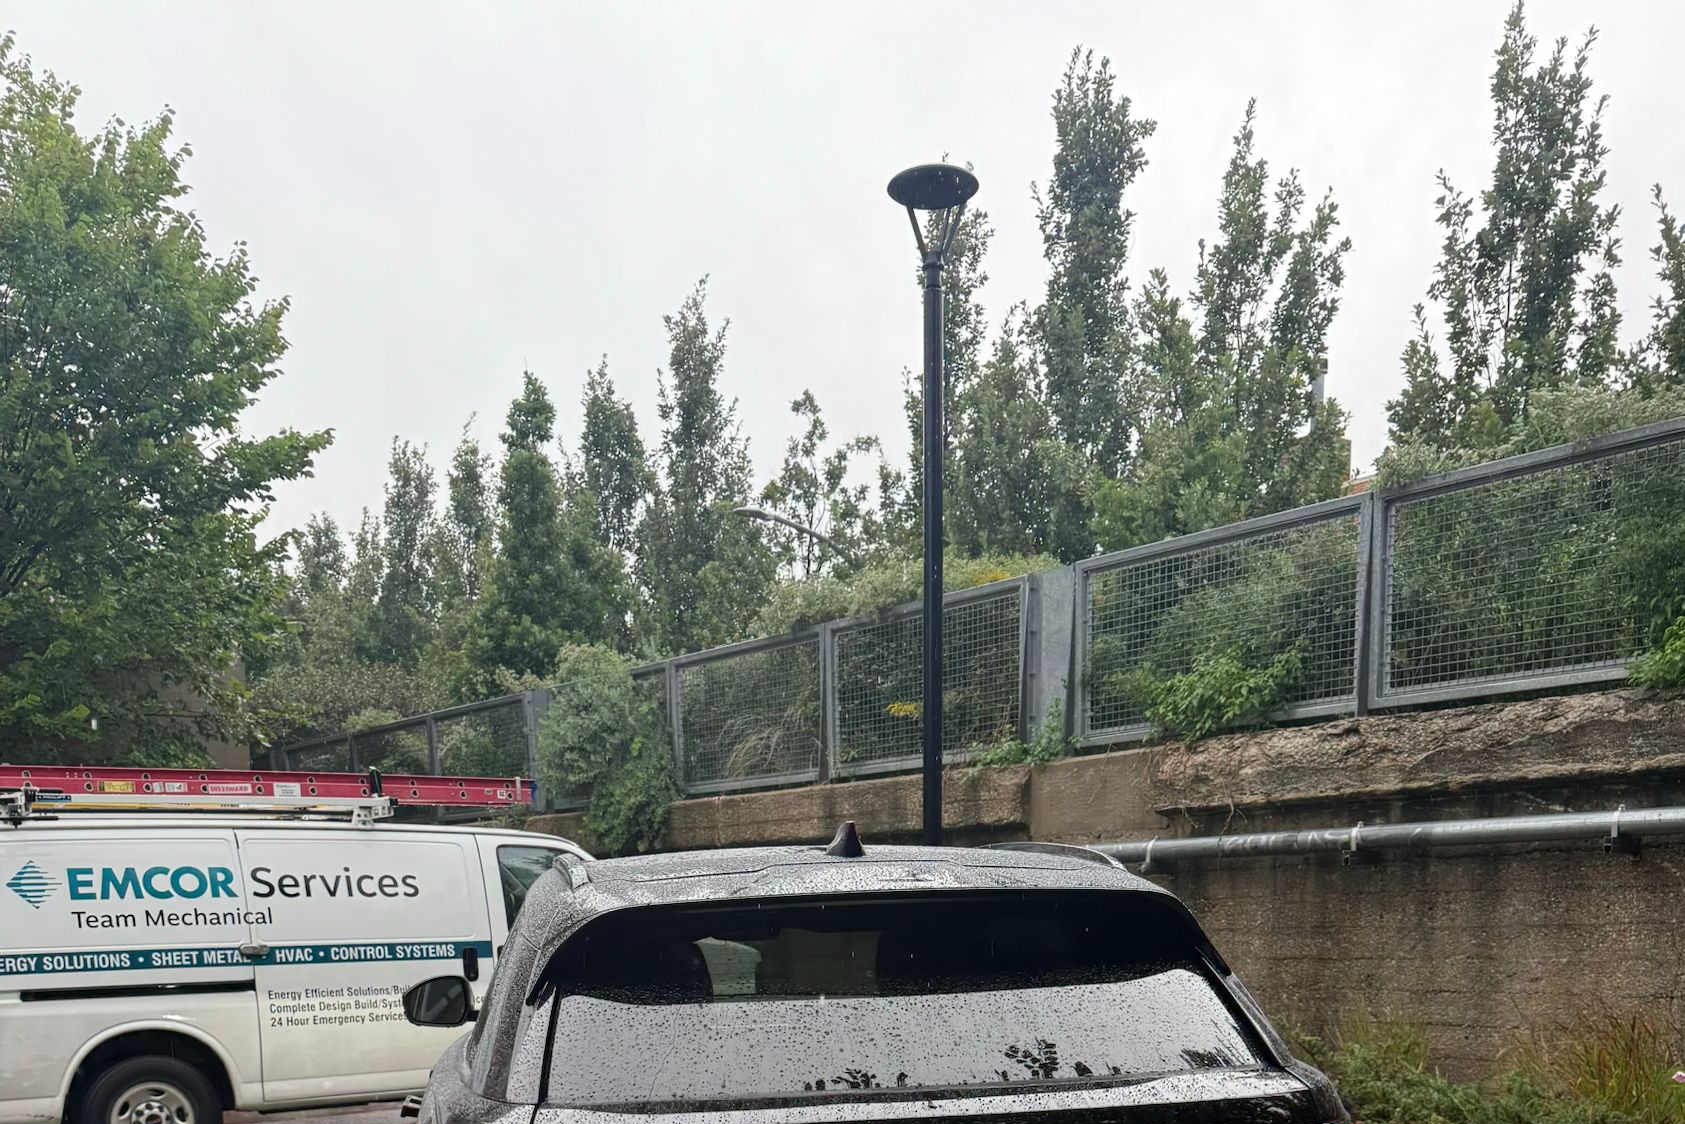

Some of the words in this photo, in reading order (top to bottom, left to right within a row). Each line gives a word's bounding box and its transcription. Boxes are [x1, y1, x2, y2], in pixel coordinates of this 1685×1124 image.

[66, 866, 239, 900] EMCOR
[250, 867, 420, 899] Services
[71, 911, 137, 929] Team
[145, 907, 273, 927] Mechanical
[0, 957, 37, 972] ERGY
[43, 953, 131, 971] SOLUTIONS
[151, 950, 199, 966] SHEET
[275, 948, 314, 963] HVAC
[331, 945, 393, 961] CONTROL
[395, 944, 456, 959] SYSTEMS
[268, 989, 302, 1001] Energy
[305, 987, 344, 999] Efficient
[269, 1003, 316, 1015] Complete
[319, 1001, 352, 1013] Design
[355, 998, 402, 1011] Build/Syst
[271, 1017, 283, 1027] 24
[286, 1016, 310, 1026] Hour
[313, 1014, 365, 1026] Emergency
